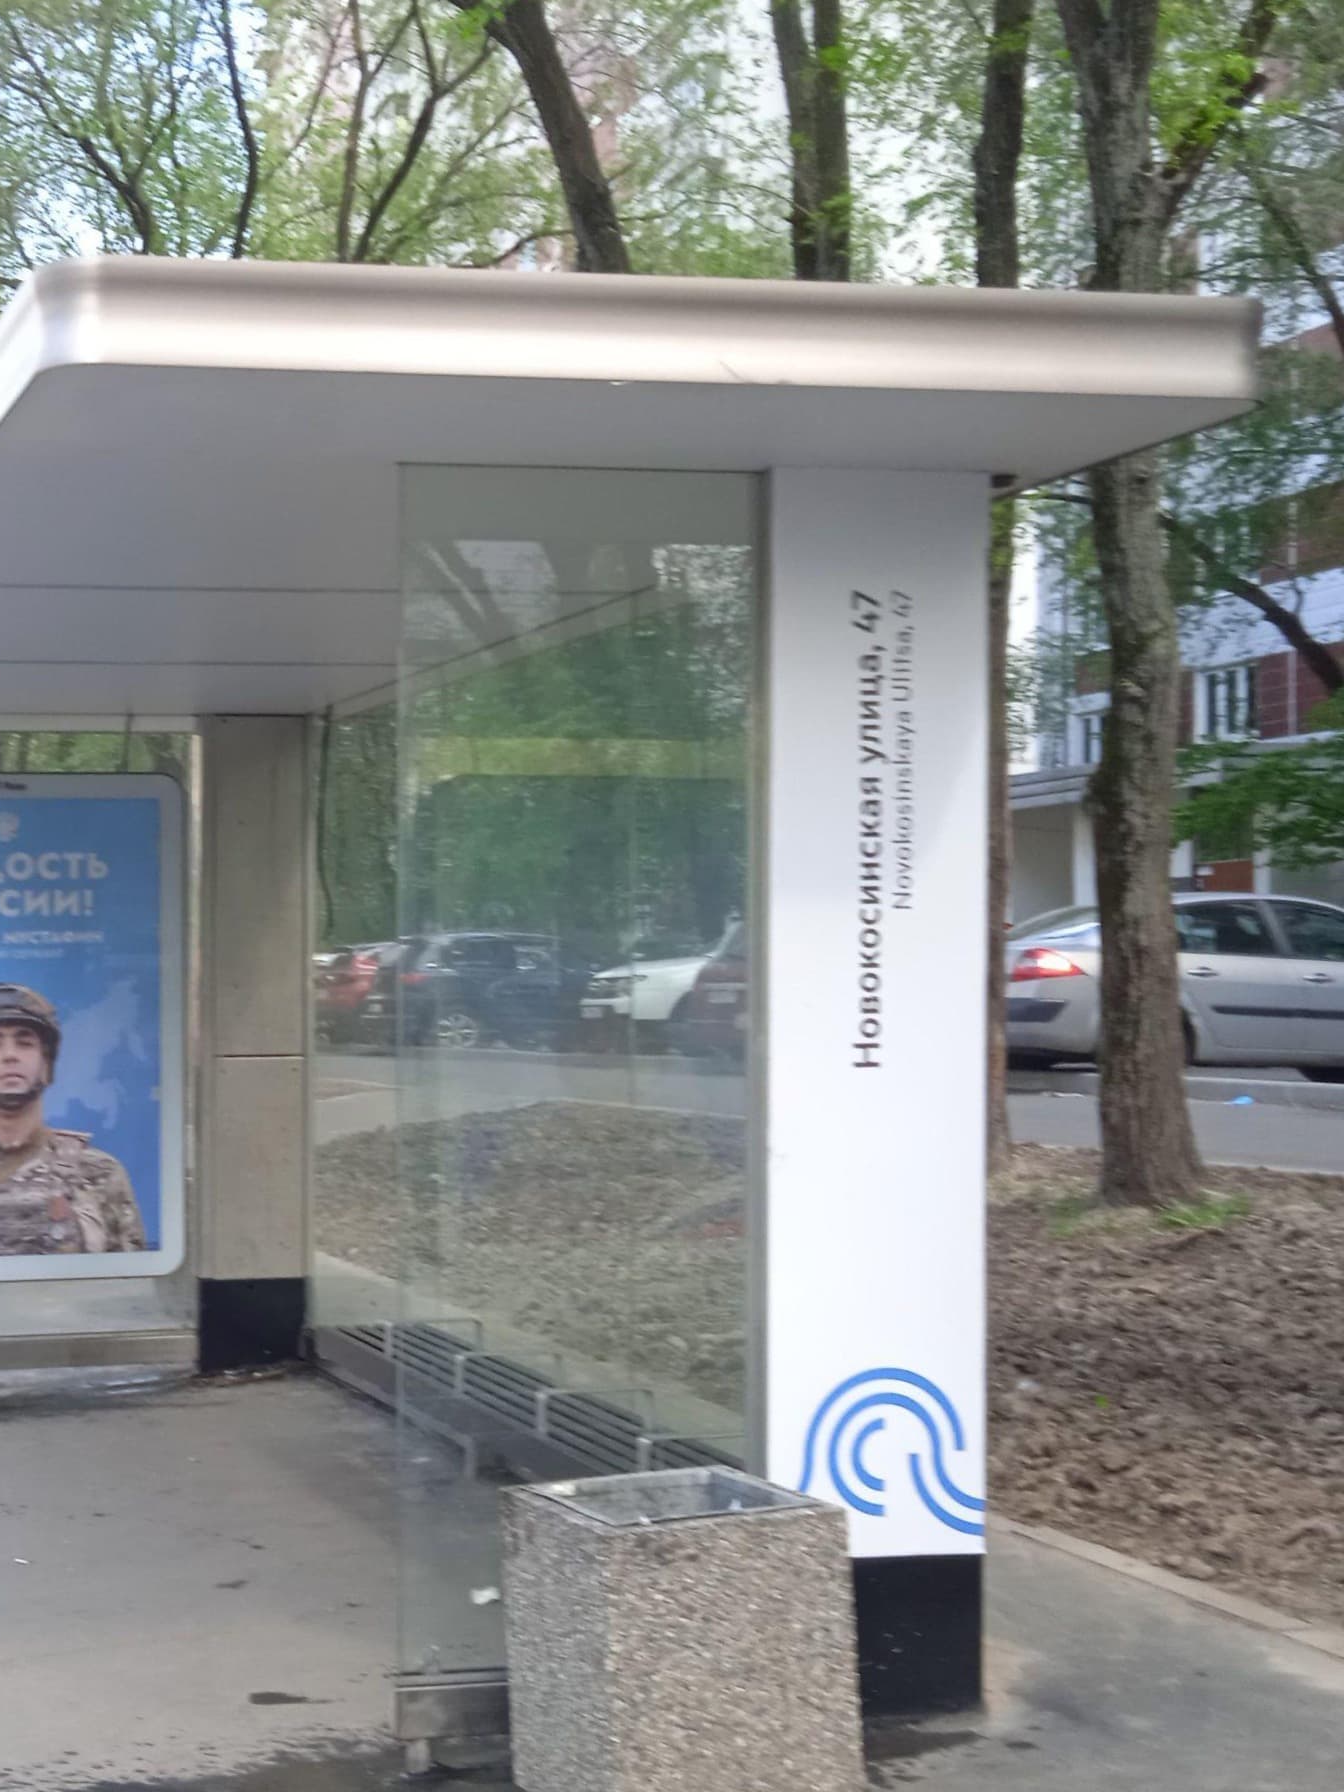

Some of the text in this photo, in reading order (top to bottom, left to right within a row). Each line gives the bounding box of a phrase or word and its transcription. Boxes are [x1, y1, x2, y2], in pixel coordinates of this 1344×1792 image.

[851, 589, 887, 1068] Новокосинская улица, 47
[890, 588, 916, 909] Novokosinskaya Ulitsa, 47
